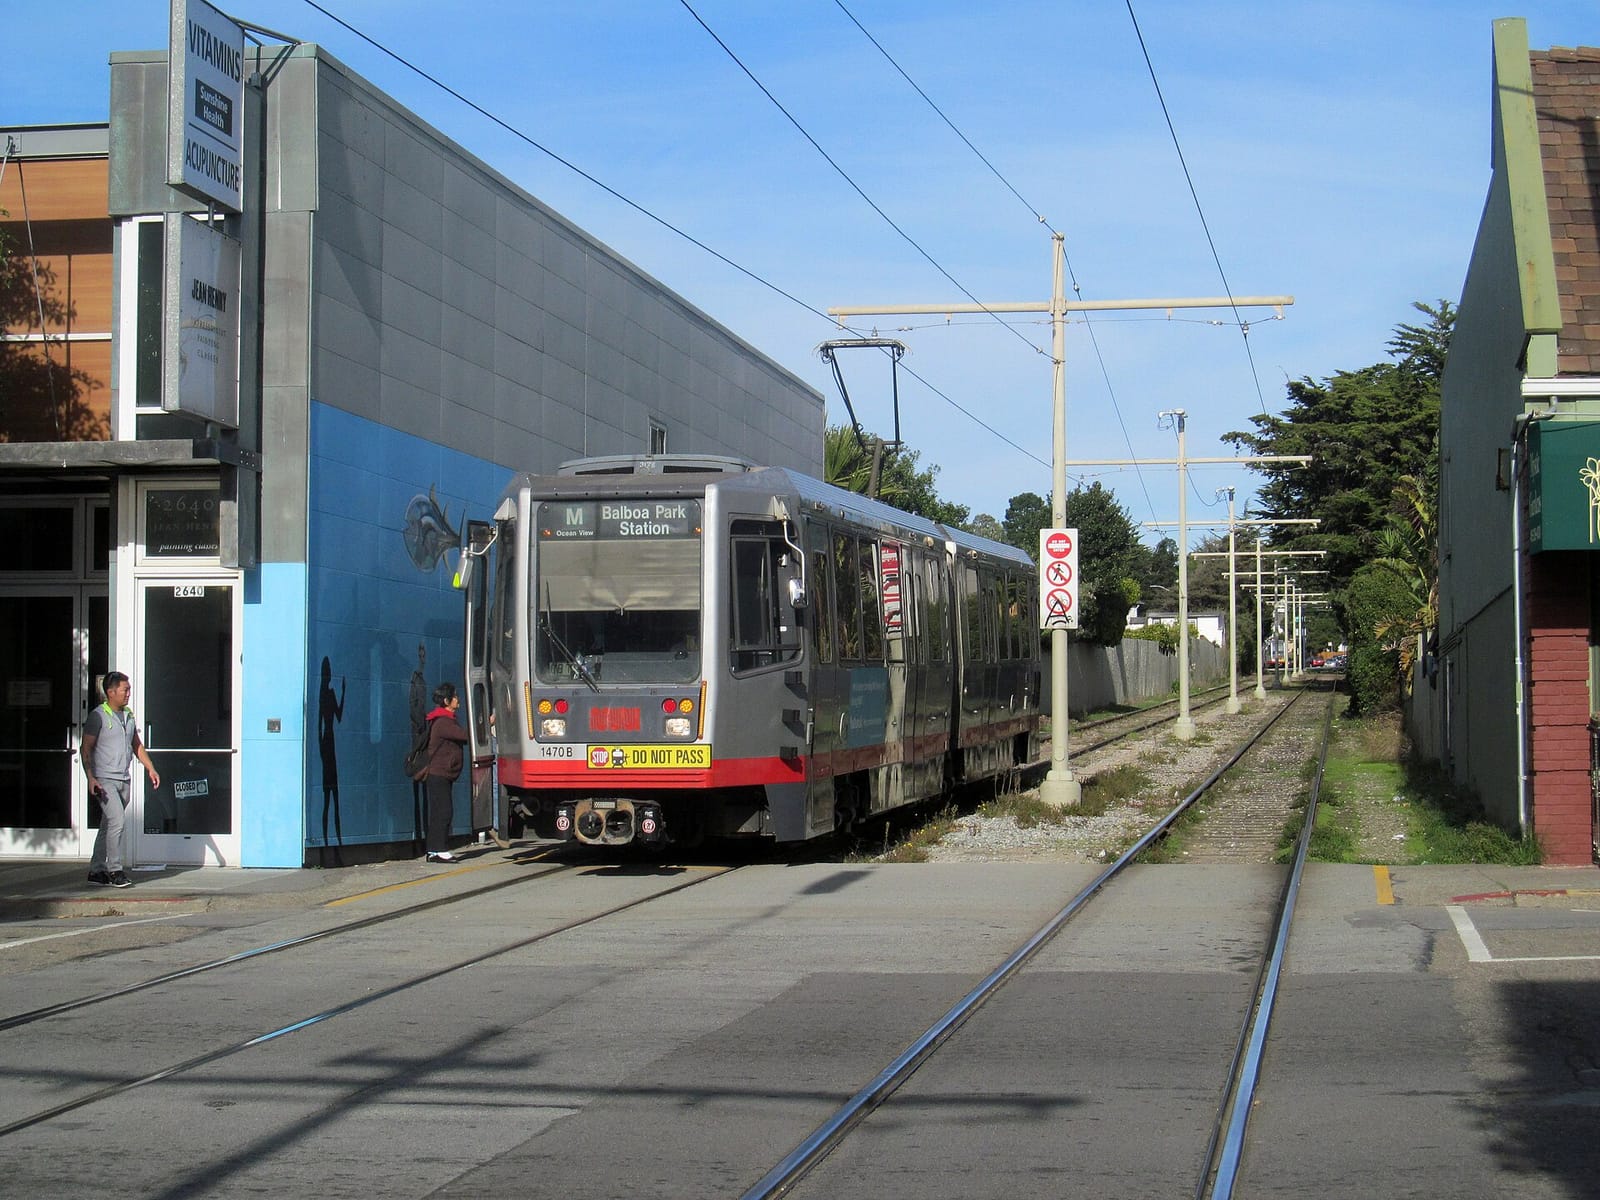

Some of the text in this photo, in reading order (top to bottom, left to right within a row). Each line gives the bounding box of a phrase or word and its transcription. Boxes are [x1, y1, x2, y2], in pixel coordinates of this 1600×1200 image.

[188, 19, 240, 83] VITAMINS
[200, 85, 229, 114] Sunshine
[203, 104, 225, 129] Health
[186, 138, 239, 193] ACUPUNCTURE
[192, 278, 227, 313] JEAN HENRY
[163, 496, 214, 511] 2640
[566, 508, 583, 525] M
[602, 505, 686, 520] Balboa Park
[619, 521, 669, 535] Station
[159, 544, 193, 552] painting
[175, 586, 203, 596] 2640
[592, 751, 608, 763] STOP
[632, 750, 703, 764] DO NOT PASS
[176, 782, 195, 791] CLOSED
